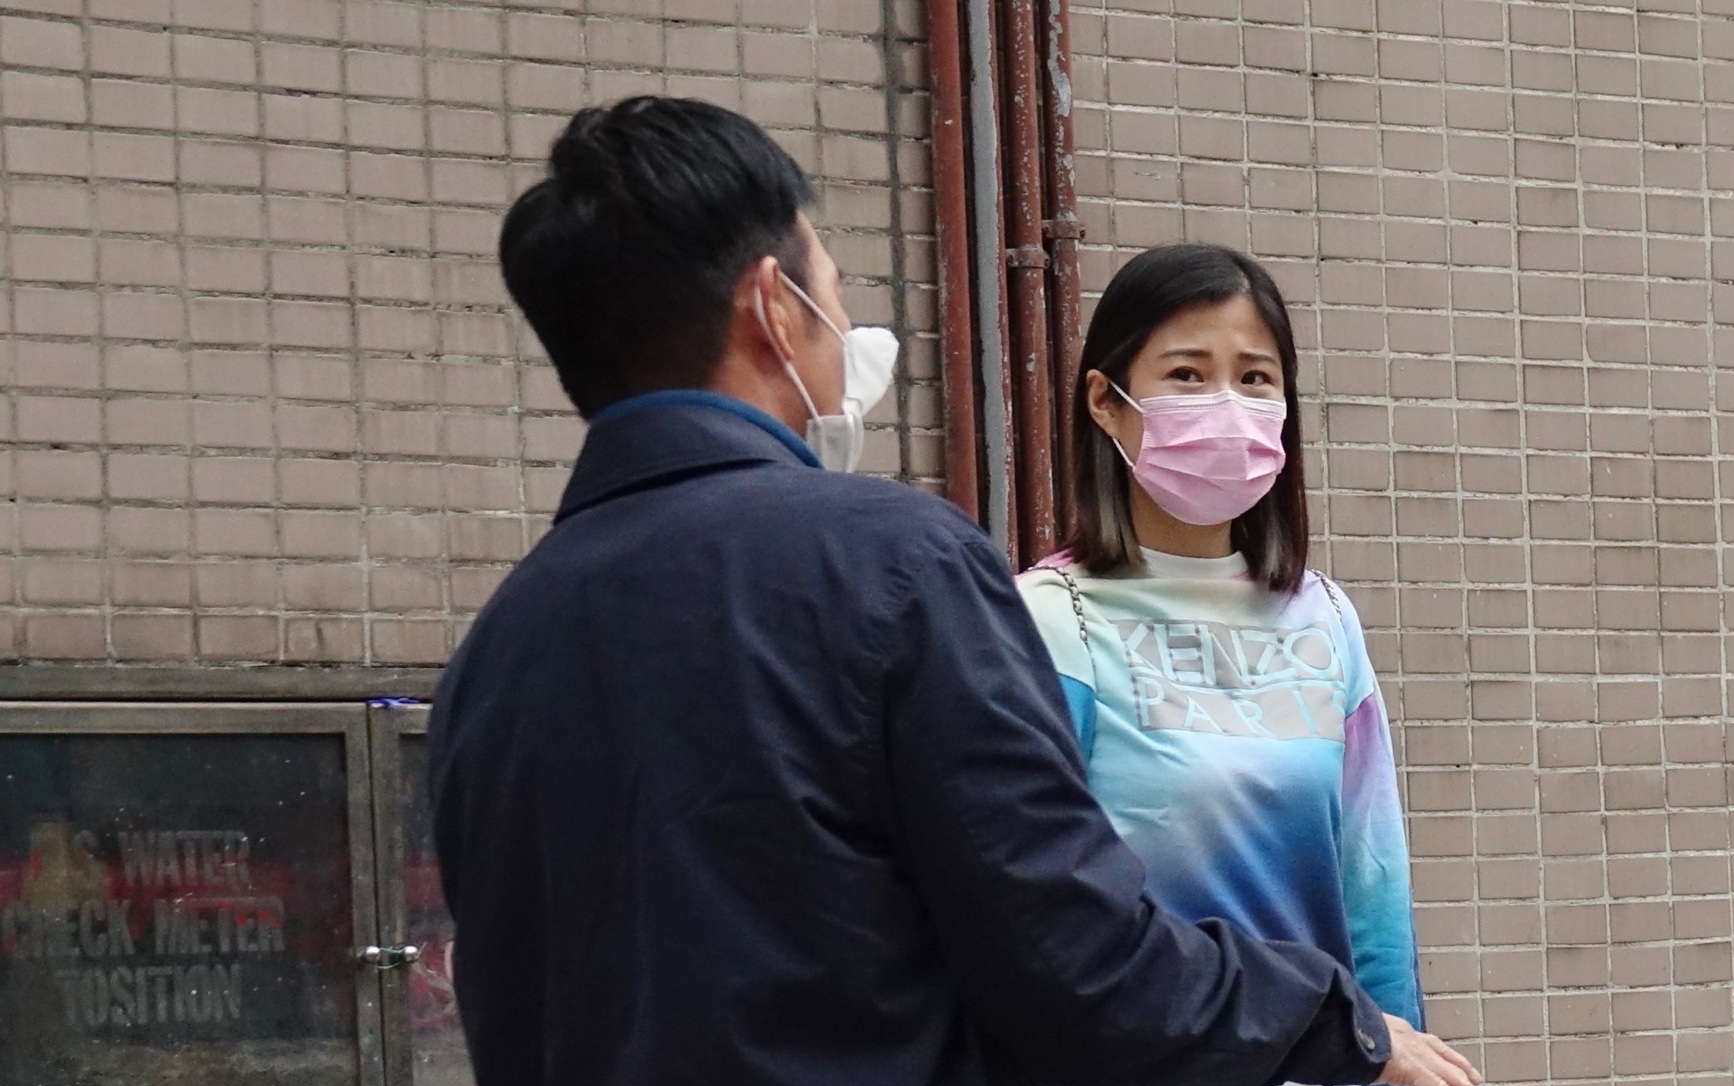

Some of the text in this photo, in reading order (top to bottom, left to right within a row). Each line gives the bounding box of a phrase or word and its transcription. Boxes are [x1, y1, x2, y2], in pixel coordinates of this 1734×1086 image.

[1112, 622, 1342, 686] KENZO
[117, 829, 251, 891] WATER
[153, 895, 286, 953] METER
